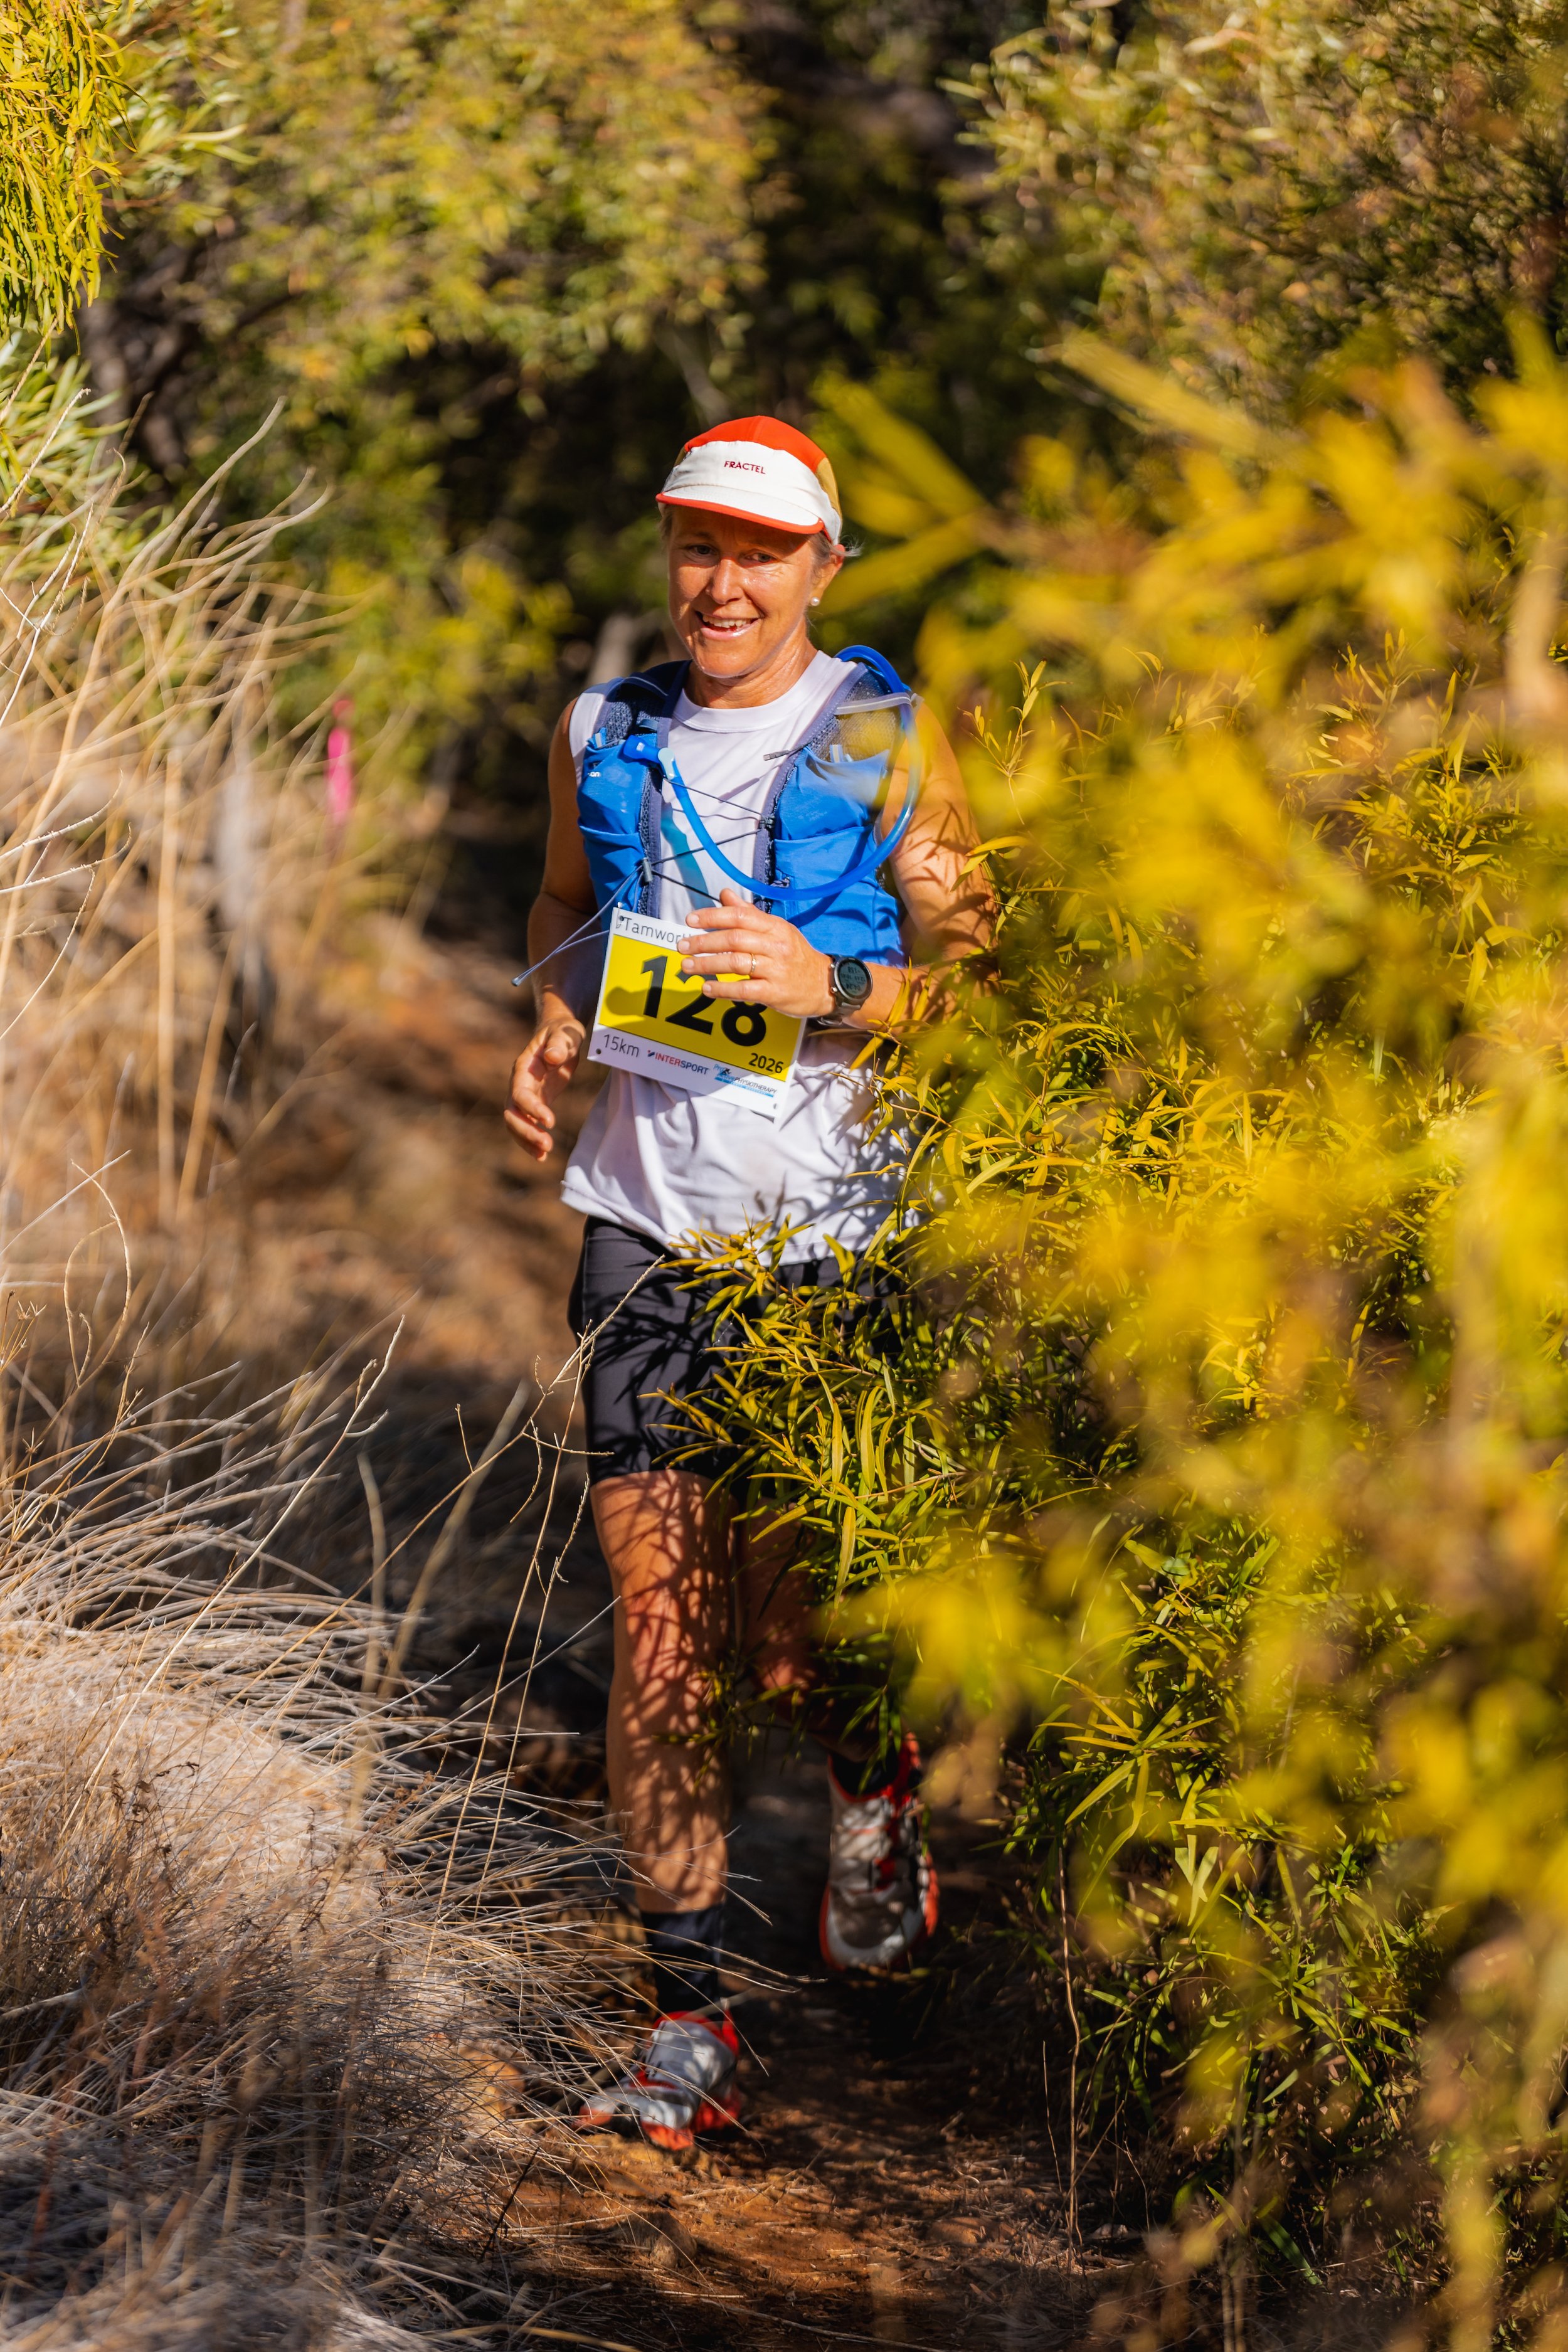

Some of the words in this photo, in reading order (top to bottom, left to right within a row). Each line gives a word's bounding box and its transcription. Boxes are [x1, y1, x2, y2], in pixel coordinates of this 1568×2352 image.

[724, 460, 766, 475] FRACTEL
[622, 916, 691, 944] Tamwor
[640, 954, 768, 1047] 128
[603, 1034, 640, 1057] 15km
[655, 1052, 709, 1075] INTERSPORT
[748, 1052, 783, 1074] 2026
